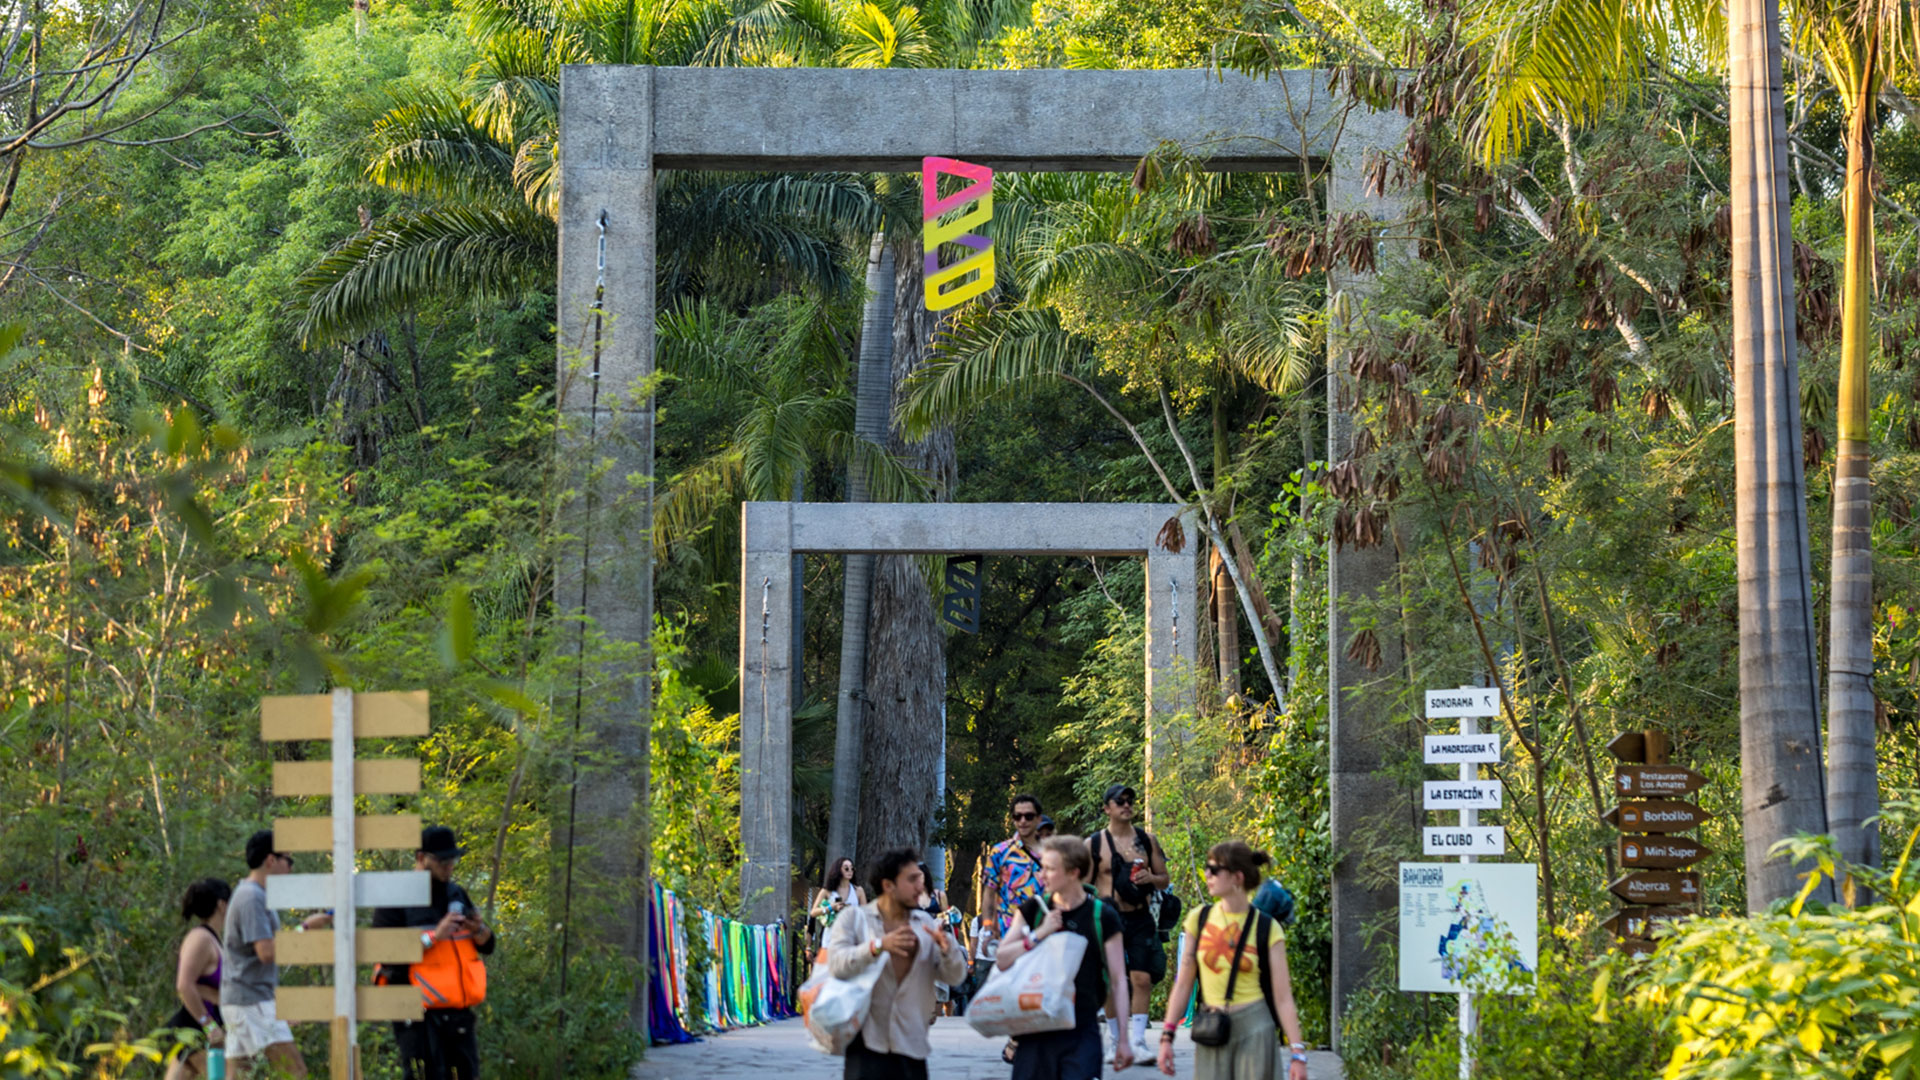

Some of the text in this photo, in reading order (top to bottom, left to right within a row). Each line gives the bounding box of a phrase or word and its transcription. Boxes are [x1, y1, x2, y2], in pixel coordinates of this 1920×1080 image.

[1431, 698, 1474, 709] SONORAMA
[1431, 744, 1486, 754] LA MADRIGUERA
[1640, 772, 1689, 780] Restaurante
[1640, 781, 1687, 789] Los Amates
[1431, 786, 1484, 800] LA ESTACIÓN
[1431, 833, 1473, 846] EL CUBO
[1644, 846, 1697, 859] Mini Super
[1628, 881, 1671, 891] Albercas
